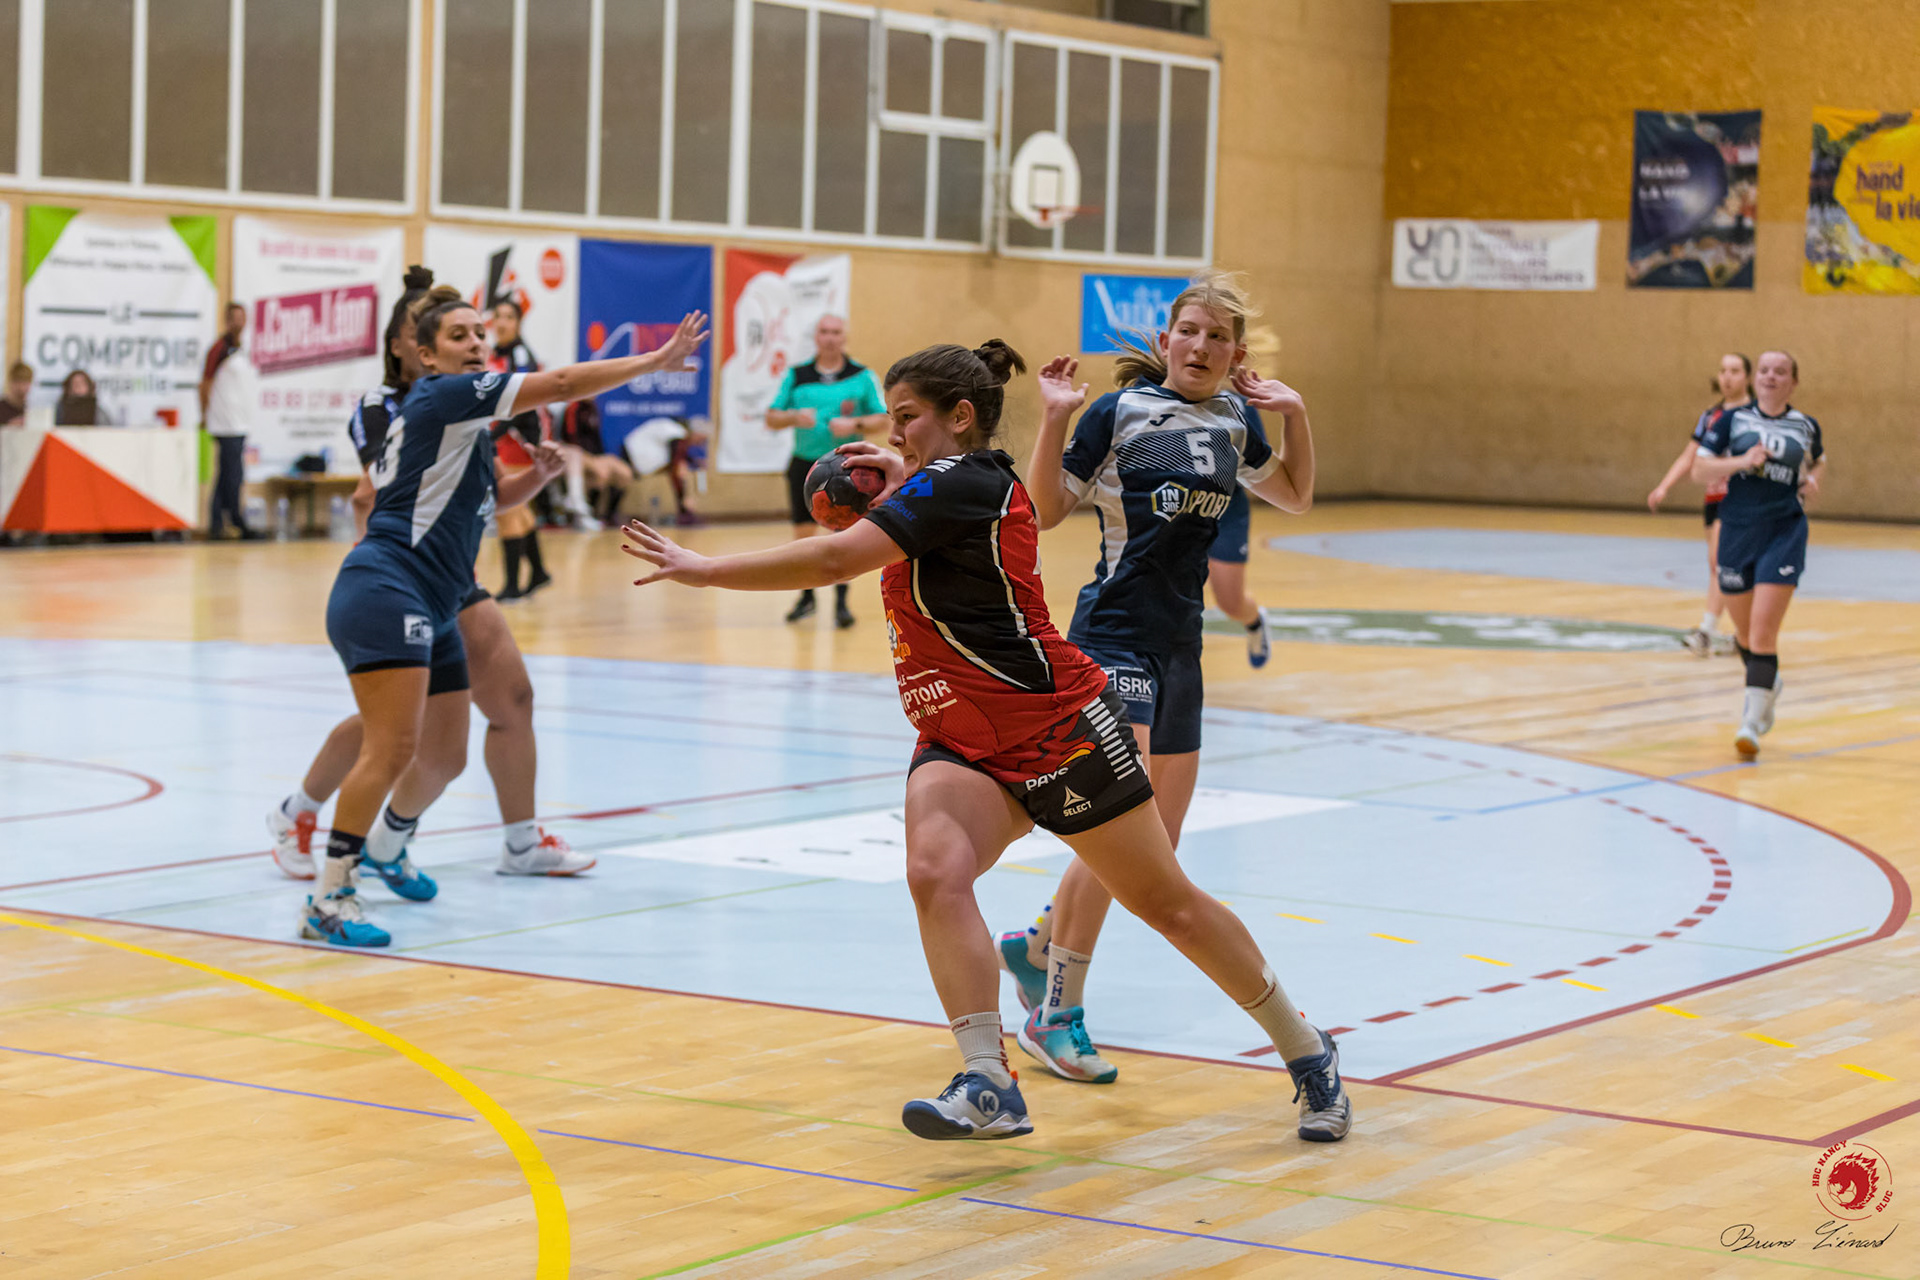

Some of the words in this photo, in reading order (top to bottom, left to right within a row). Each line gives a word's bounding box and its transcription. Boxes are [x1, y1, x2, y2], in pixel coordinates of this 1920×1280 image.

[1856, 163, 1904, 192] hand
[1875, 191, 1893, 220] la
[37, 334, 199, 369] COMPTOIR
[1186, 431, 1216, 475] 5
[1161, 488, 1180, 502] IN
[1162, 501, 1181, 513] SIDE
[1188, 489, 1232, 521] SPORT
[901, 679, 952, 712] PTOIR
[1118, 676, 1153, 695] SRK
[1062, 800, 1093, 818] SELECT
[1049, 961, 1067, 1007] TCHB
